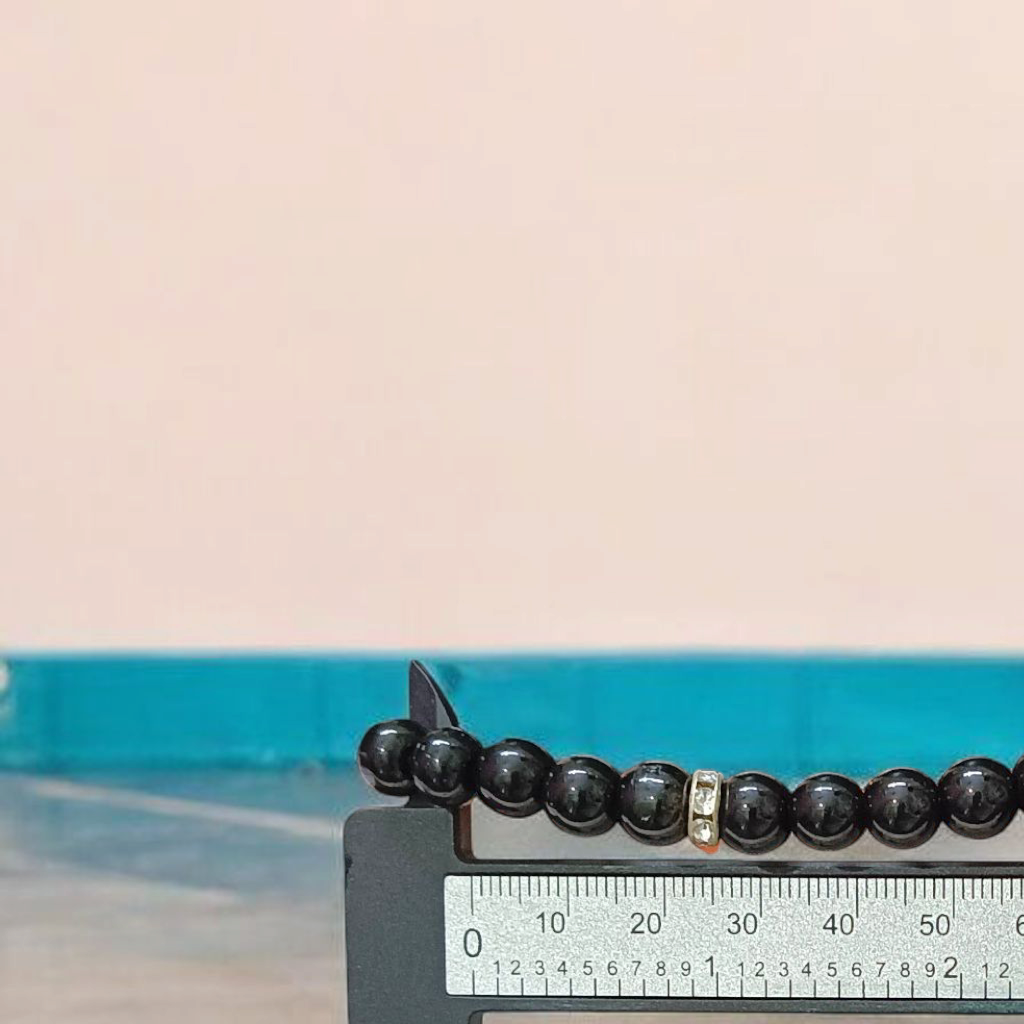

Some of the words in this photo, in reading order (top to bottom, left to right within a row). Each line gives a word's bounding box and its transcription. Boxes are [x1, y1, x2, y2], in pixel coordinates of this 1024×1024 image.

[536, 912, 565, 934] 10
[630, 913, 662, 934] 20
[727, 913, 758, 934] 30
[823, 914, 854, 936] 40
[919, 914, 950, 936] 50
[463, 929, 482, 957] 0
[493, 960, 500, 976] 1
[510, 960, 521, 976] 2
[535, 960, 545, 976] 3
[557, 960, 568, 976] 4
[582, 960, 593, 976] 5
[607, 960, 618, 976] 6
[631, 960, 642, 976] 7
[656, 960, 666, 976] 8
[680, 960, 691, 976] 9
[705, 956, 715, 976] 1
[737, 962, 745, 977] 1
[754, 962, 765, 977] 2
[778, 962, 789, 977] 3
[802, 962, 811, 977] 4
[827, 962, 837, 977] 5
[851, 962, 862, 977] 6
[876, 962, 886, 977] 7
[900, 962, 910, 977] 8
[925, 962, 935, 977] 9
[943, 957, 958, 978] 2
[981, 963, 988, 978] 1
[999, 963, 1010, 978] 2
